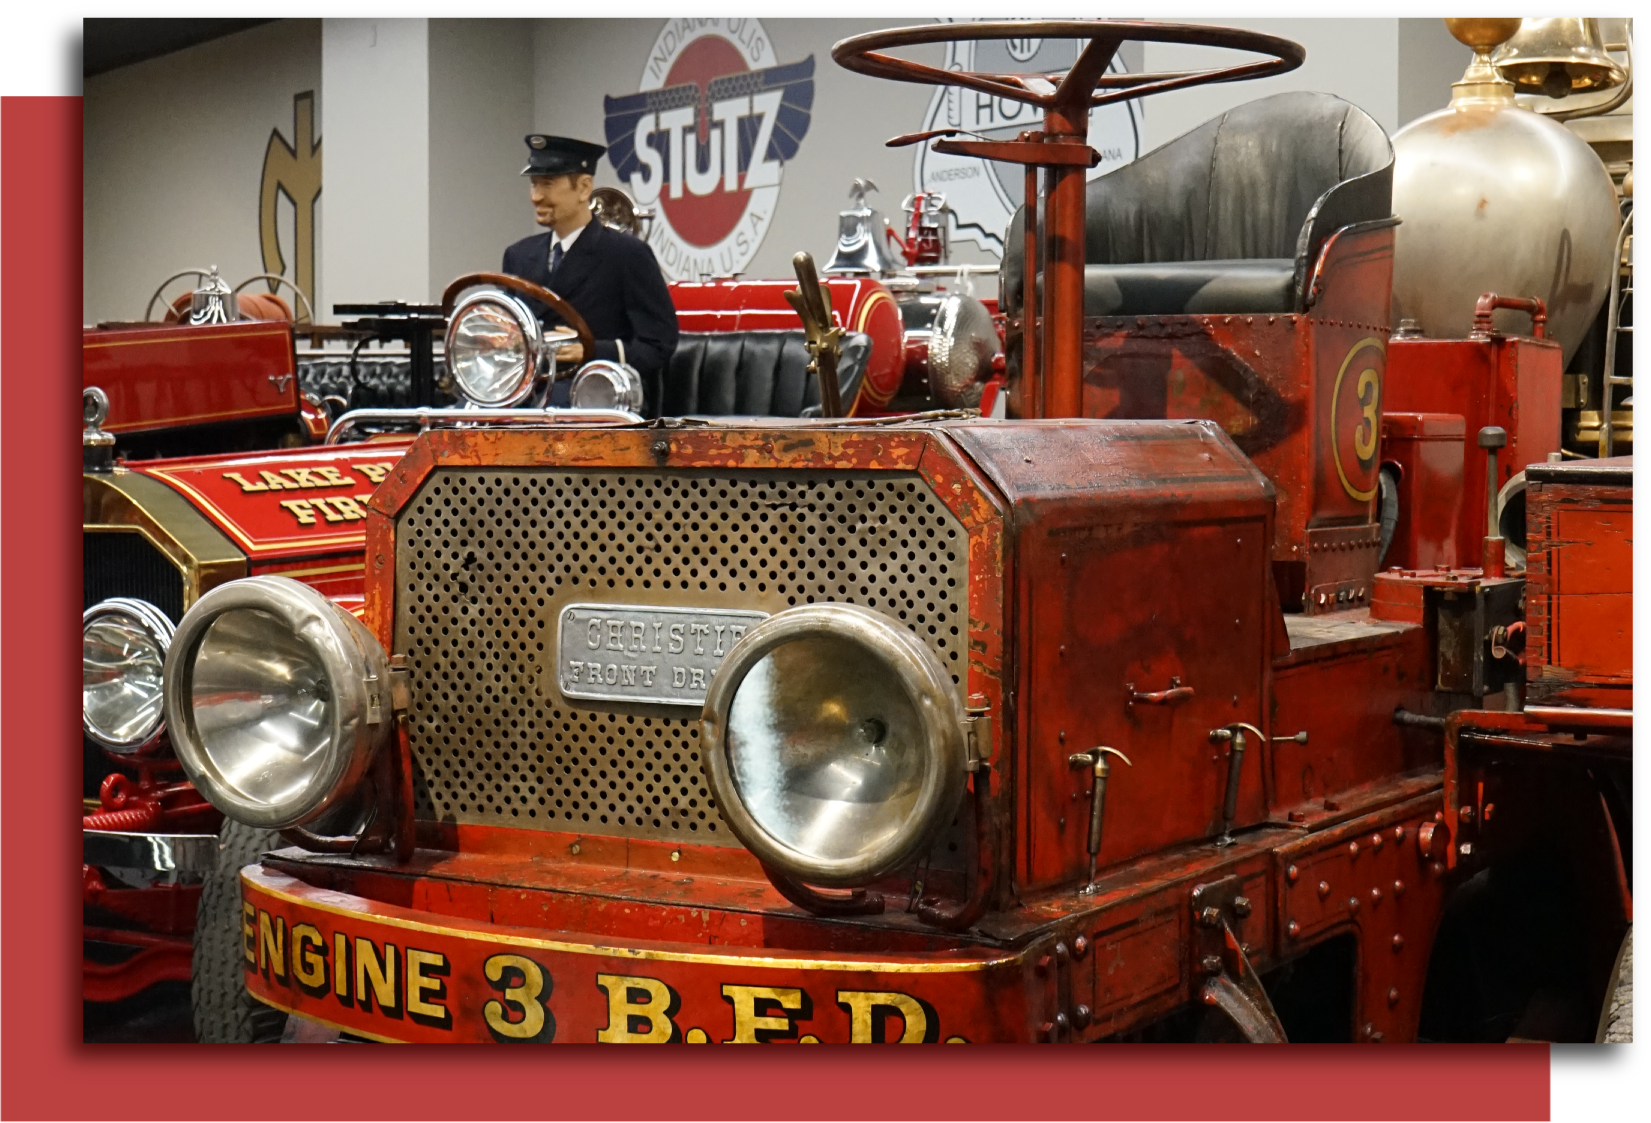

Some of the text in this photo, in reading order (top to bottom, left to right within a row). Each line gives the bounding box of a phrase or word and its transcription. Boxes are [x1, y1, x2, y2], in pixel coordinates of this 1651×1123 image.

[630, 89, 785, 206] STUTZ
[930, 165, 980, 182] ANDERSON
[652, 222, 715, 281] INDIANA
[1355, 368, 1380, 462] 3
[223, 465, 356, 492] LAKE
[569, 661, 717, 690] FRONT DR
[243, 901, 452, 1027] ENGINE
[483, 953, 554, 1042] 3
